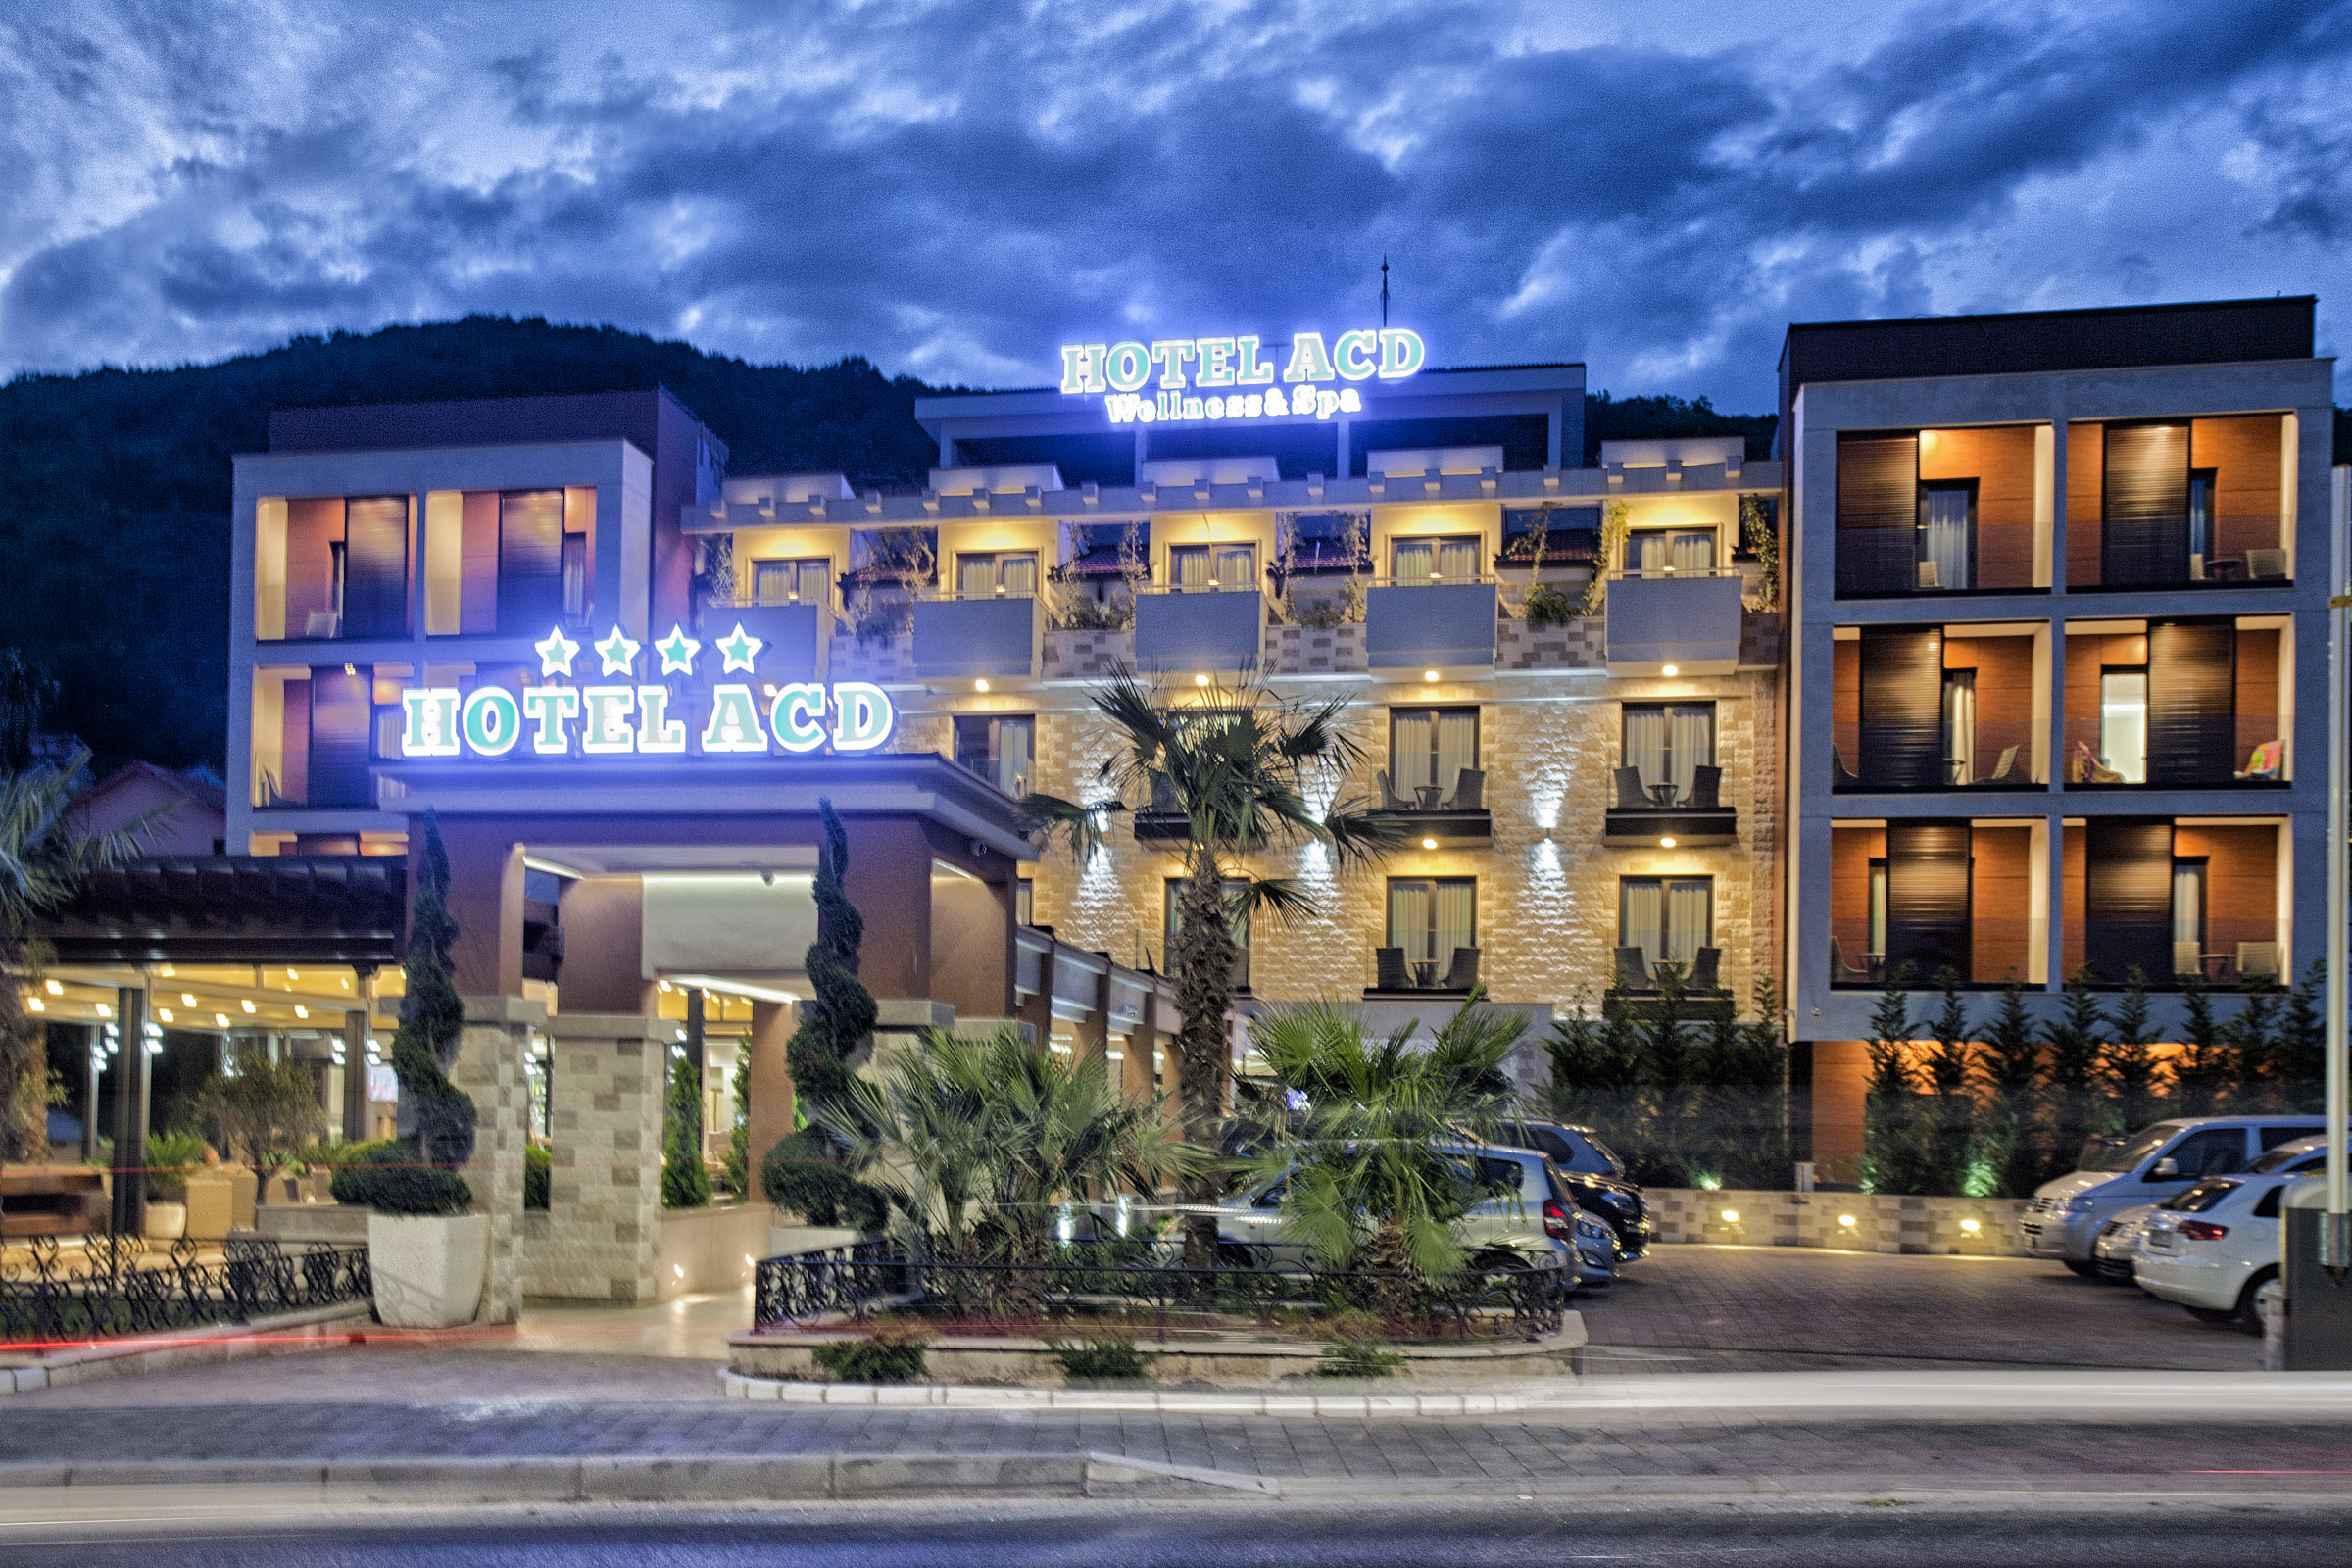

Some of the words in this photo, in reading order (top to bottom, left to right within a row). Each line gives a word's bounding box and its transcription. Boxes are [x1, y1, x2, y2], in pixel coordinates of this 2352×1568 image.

[1061, 335, 1274, 394] HOTEL
[1284, 327, 1425, 383] ACD
[402, 686, 686, 756] HOTEL
[702, 682, 894, 753] ACD
